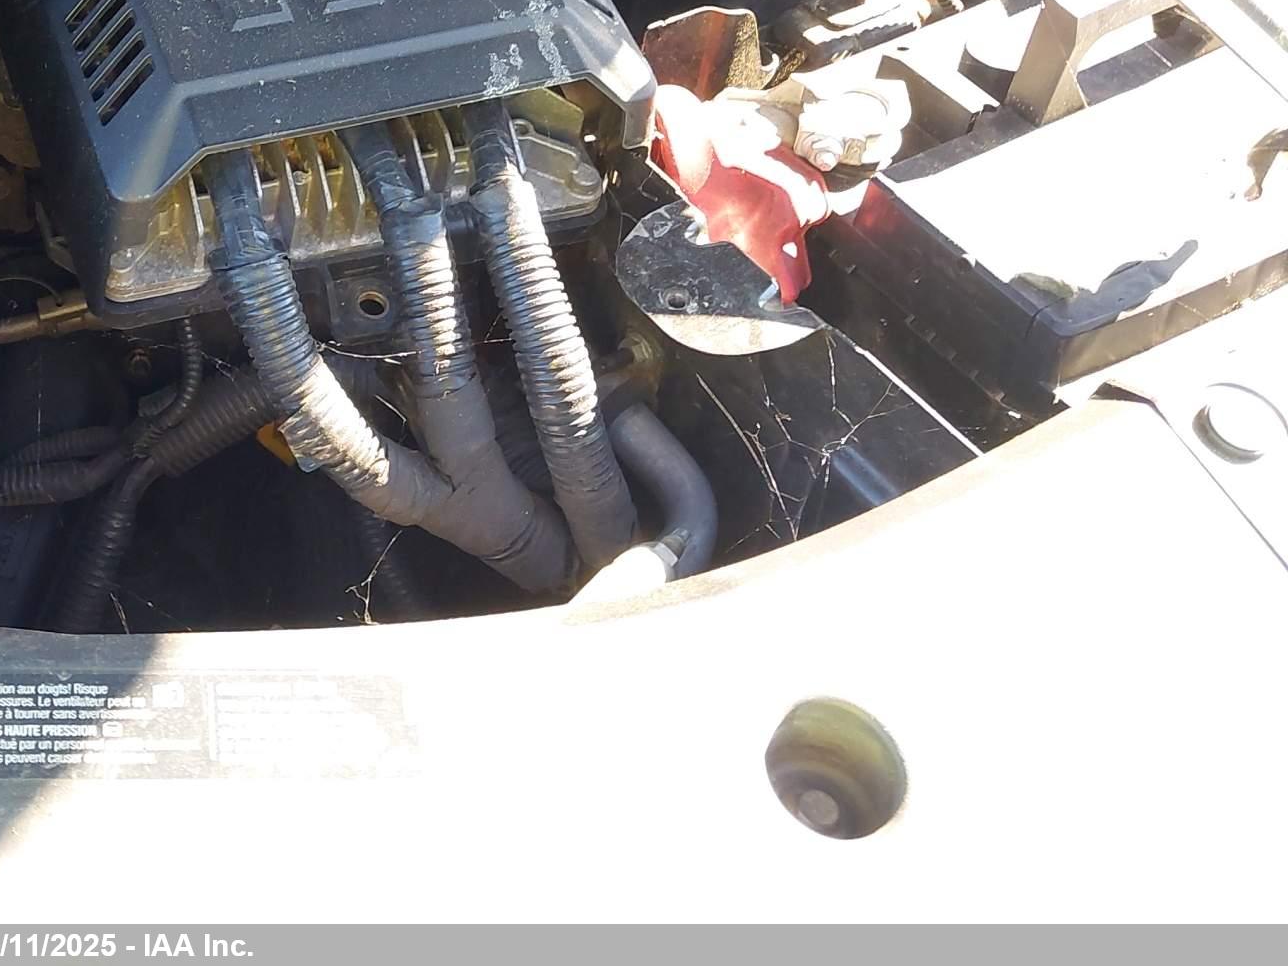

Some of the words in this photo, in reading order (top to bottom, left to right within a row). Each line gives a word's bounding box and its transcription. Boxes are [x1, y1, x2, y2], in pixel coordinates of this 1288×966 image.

[17, 684, 36, 694] aux
[37, 684, 72, 696] doigts!
[73, 683, 109, 696] Risque
[37, 696, 51, 707] Le
[5, 707, 13, 719] à
[14, 708, 51, 719] tourner
[52, 709, 78, 719] sans
[4, 725, 41, 736] HAUTE
[19, 740, 37, 752] par
[38, 741, 53, 750] un
[5, 753, 46, 765] peuvent
